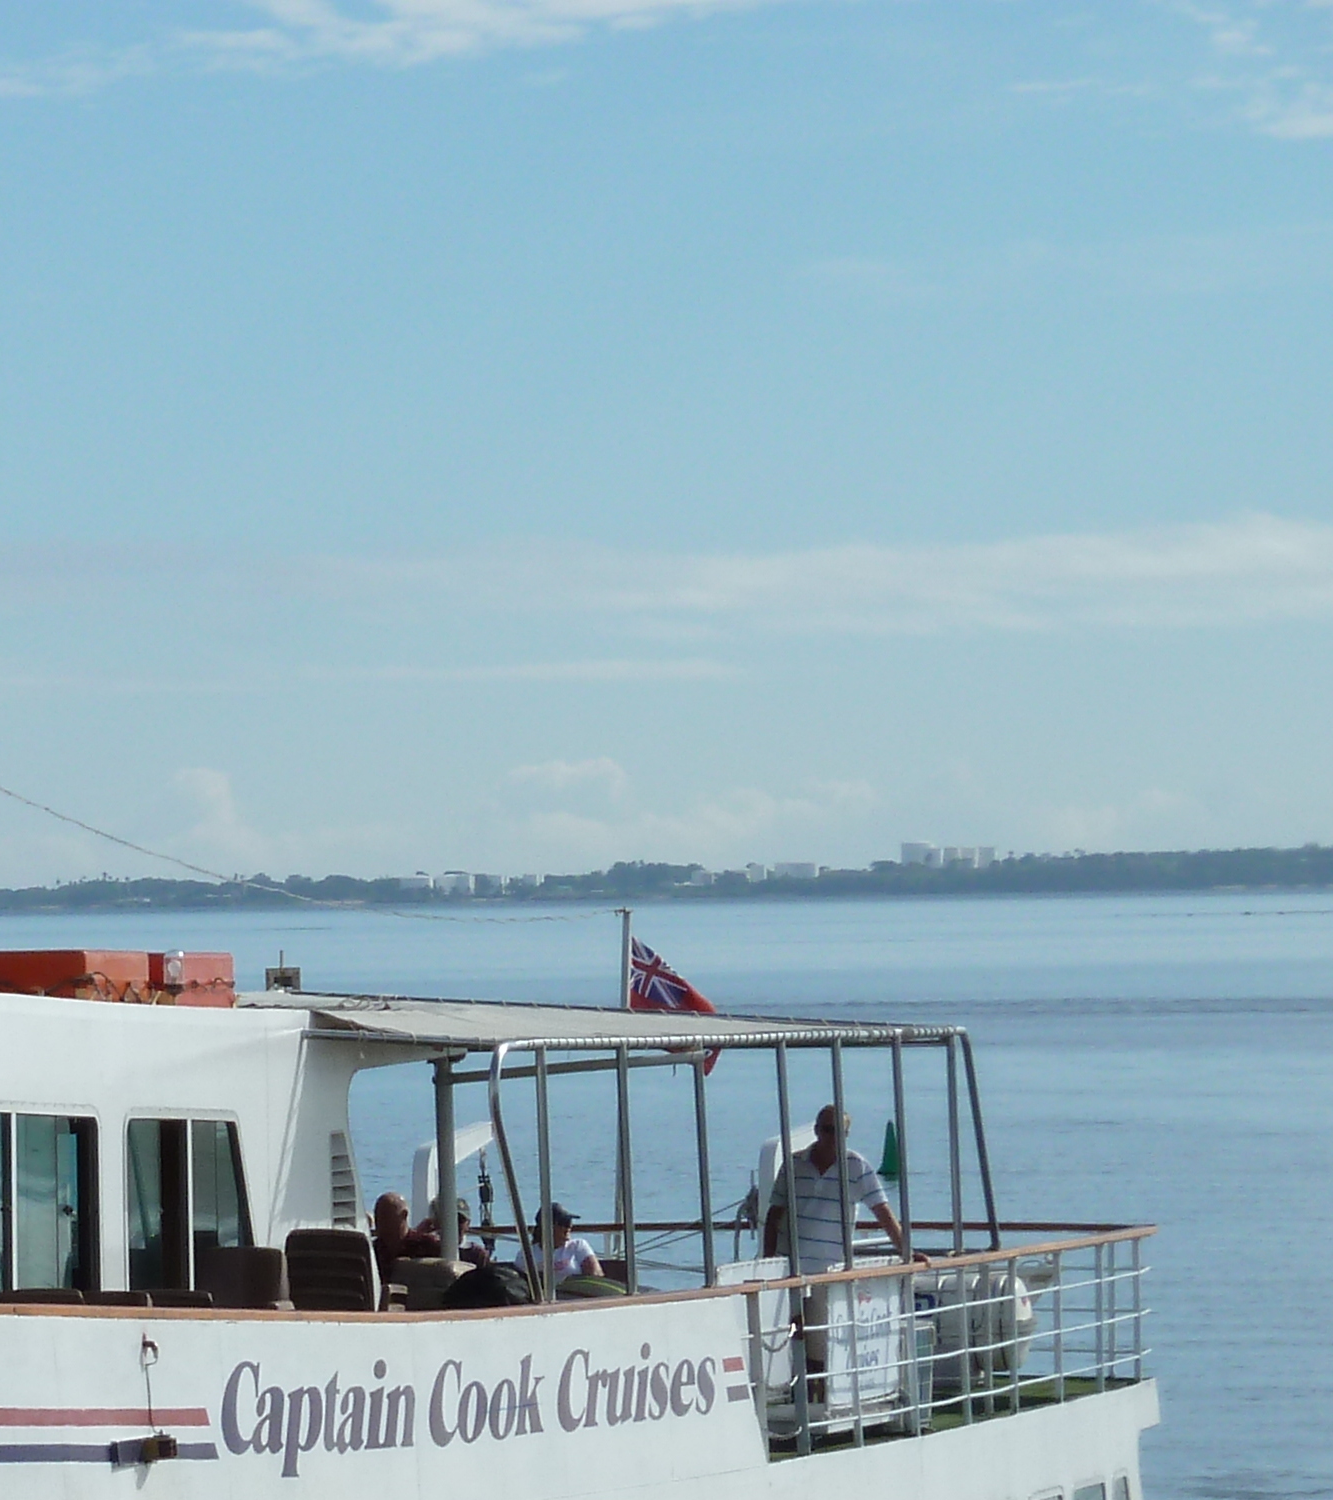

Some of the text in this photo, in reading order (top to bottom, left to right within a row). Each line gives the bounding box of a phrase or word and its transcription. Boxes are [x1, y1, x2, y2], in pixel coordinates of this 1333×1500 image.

[220, 1342, 716, 1478] Captain Cook Cruises
